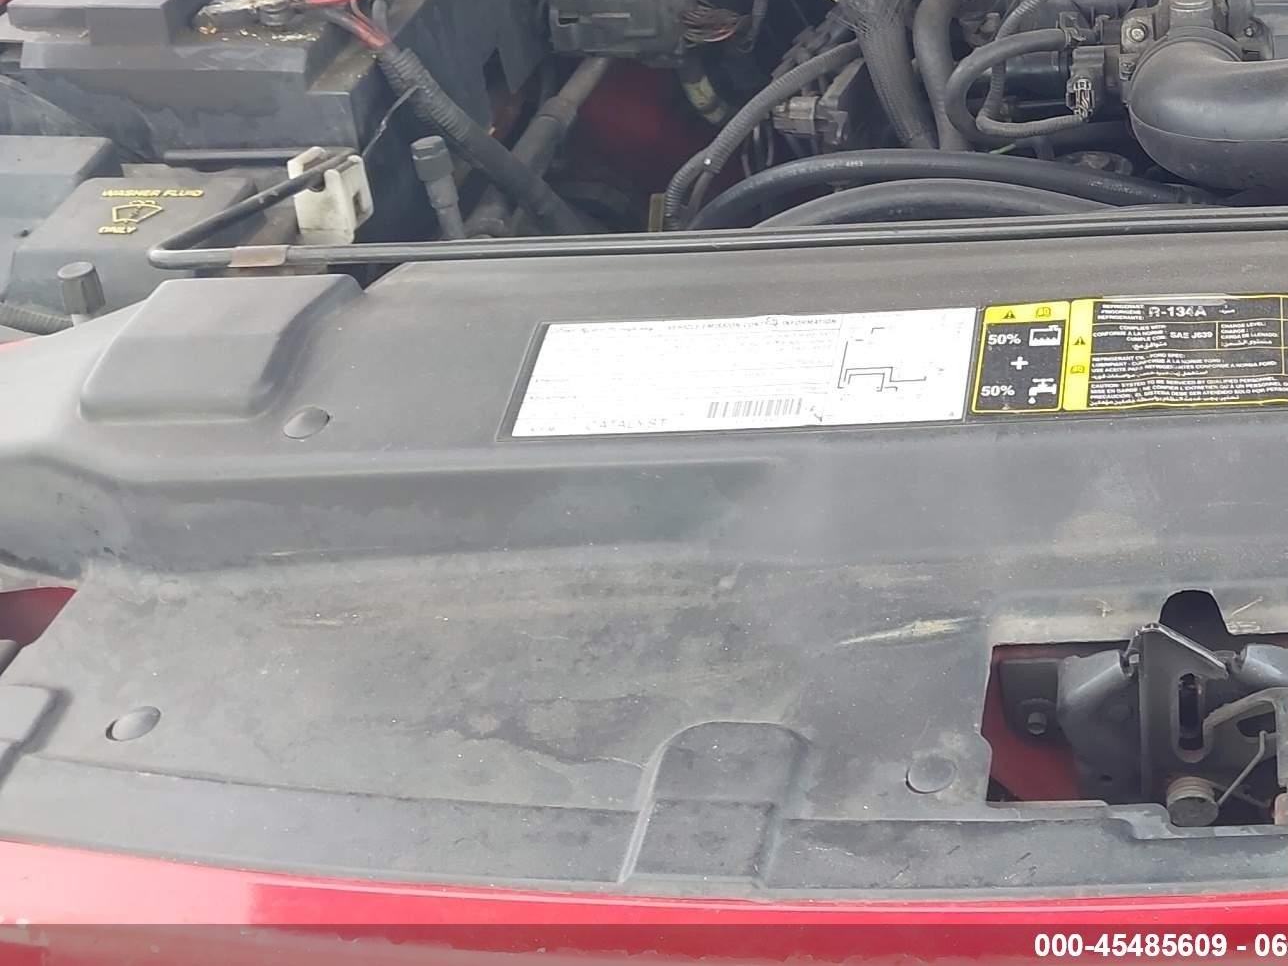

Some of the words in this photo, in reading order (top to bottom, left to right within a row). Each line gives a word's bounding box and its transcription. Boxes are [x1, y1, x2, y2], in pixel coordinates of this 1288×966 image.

[101, 189, 161, 198] WASHER
[163, 188, 204, 198] FLUID
[1148, 305, 1208, 319] R-134A
[987, 333, 1022, 346] 50%
[980, 385, 1016, 397] 50%
